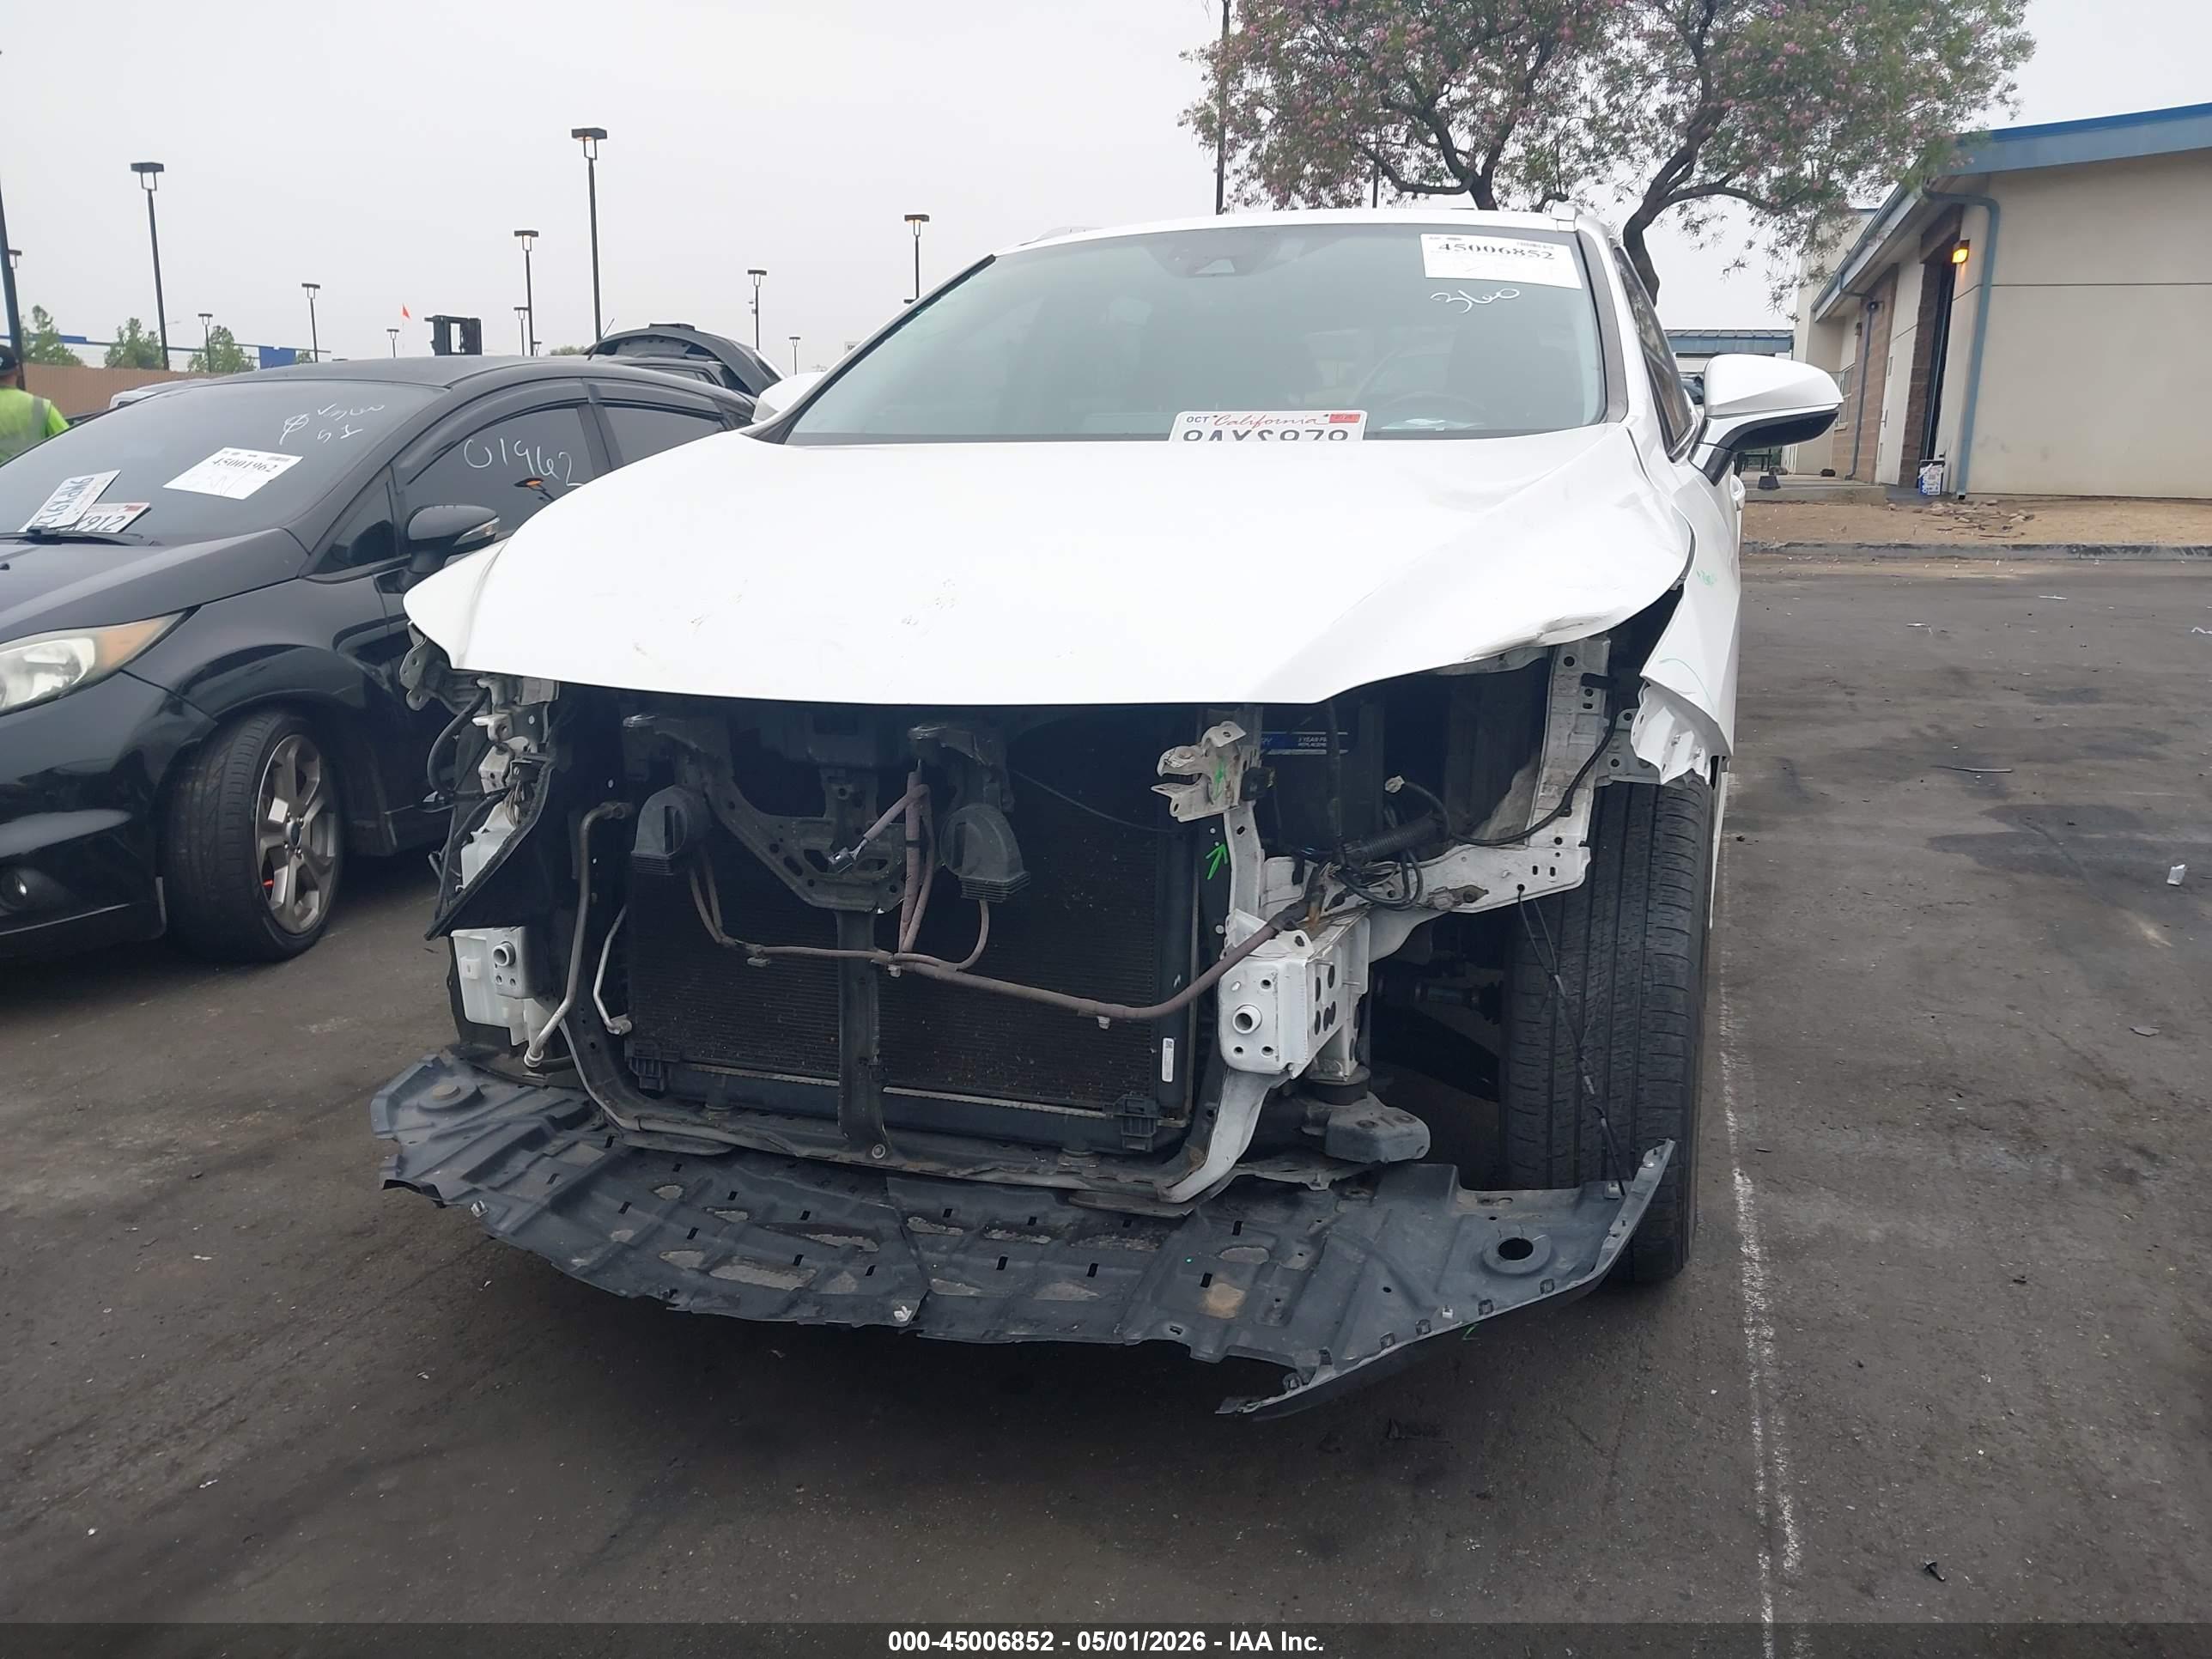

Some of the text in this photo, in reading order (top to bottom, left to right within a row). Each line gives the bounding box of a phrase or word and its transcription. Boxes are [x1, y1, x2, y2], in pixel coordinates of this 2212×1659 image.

[1438, 243, 1555, 260] 45006852
[1213, 414, 1330, 429] California
[213, 458, 279, 473] 45001962
